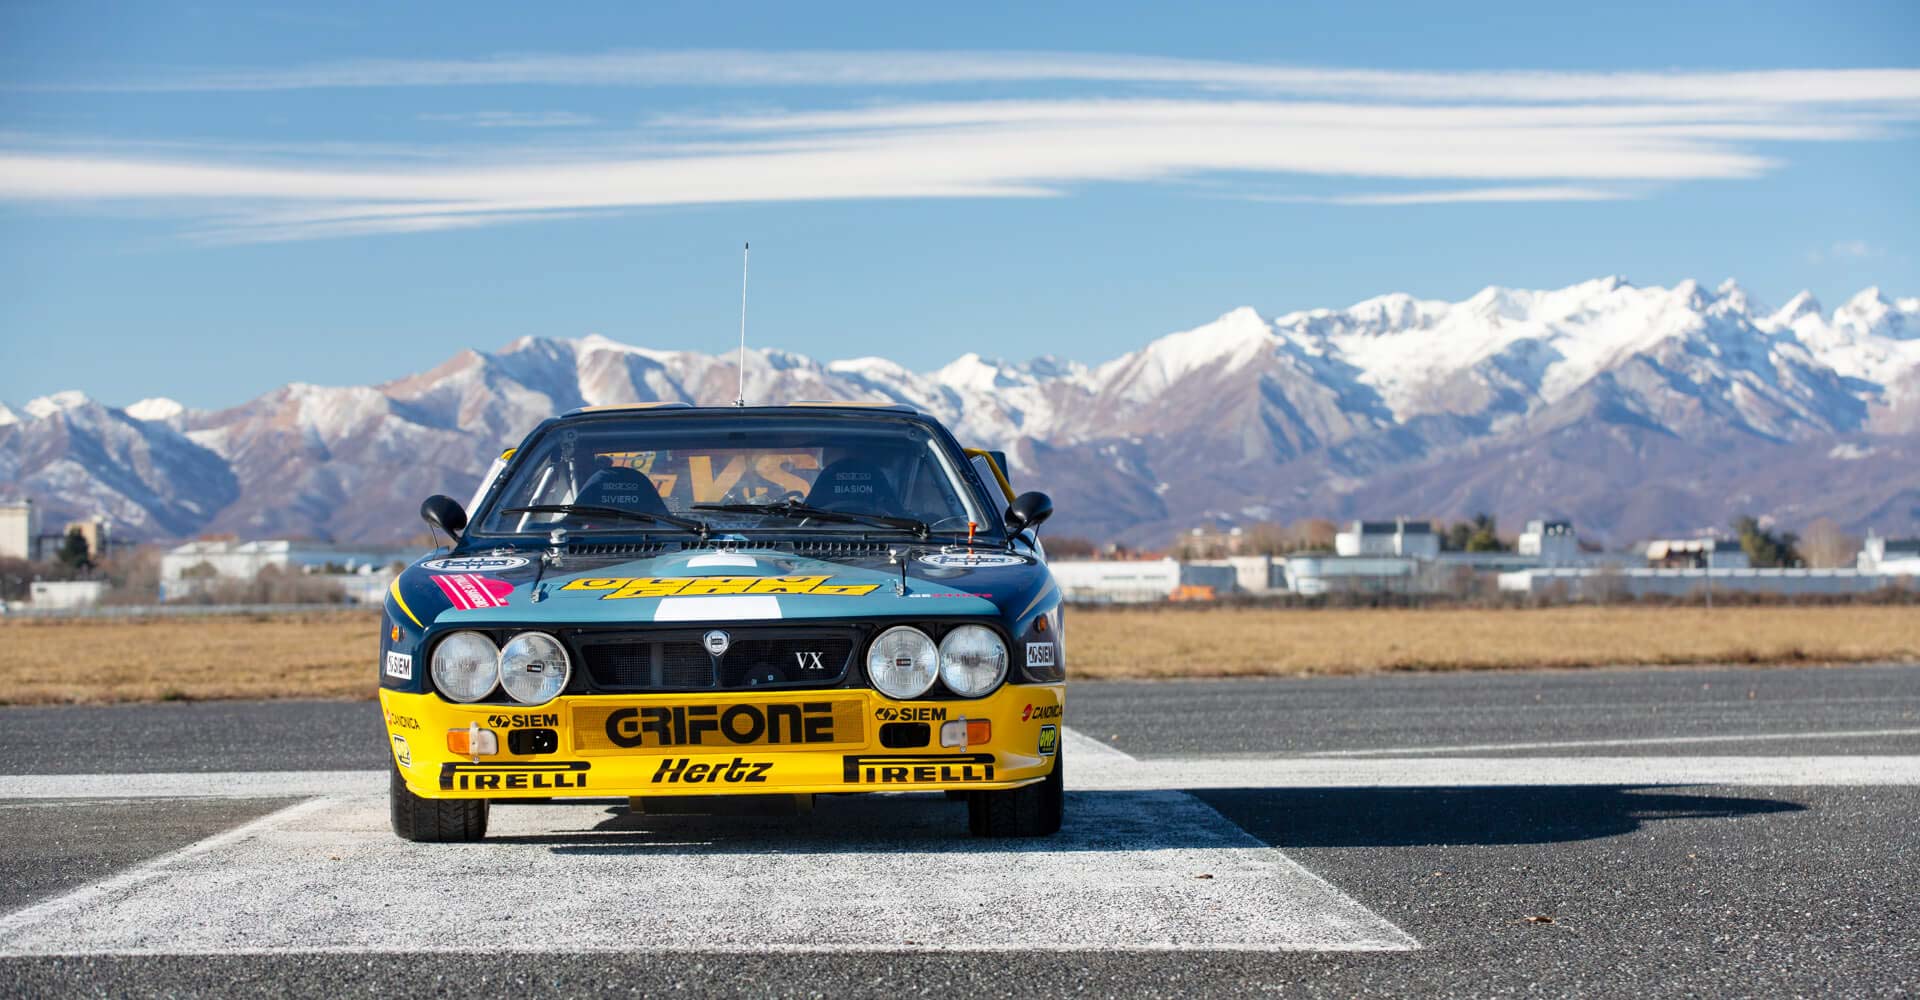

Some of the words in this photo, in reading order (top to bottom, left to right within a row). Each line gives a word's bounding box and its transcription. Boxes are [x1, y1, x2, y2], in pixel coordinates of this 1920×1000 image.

[834, 485, 873, 494] BIASION
[601, 495, 639, 504] SIVIERO
[795, 652, 824, 669] VX
[512, 714, 559, 728] SIEM
[900, 708, 947, 721] SIEM
[605, 702, 834, 748] GRIFONE
[1040, 729, 1055, 747] OMP
[439, 761, 591, 790] PIRELLI
[651, 757, 774, 783] Hertz
[843, 754, 996, 783] PIRELLI
